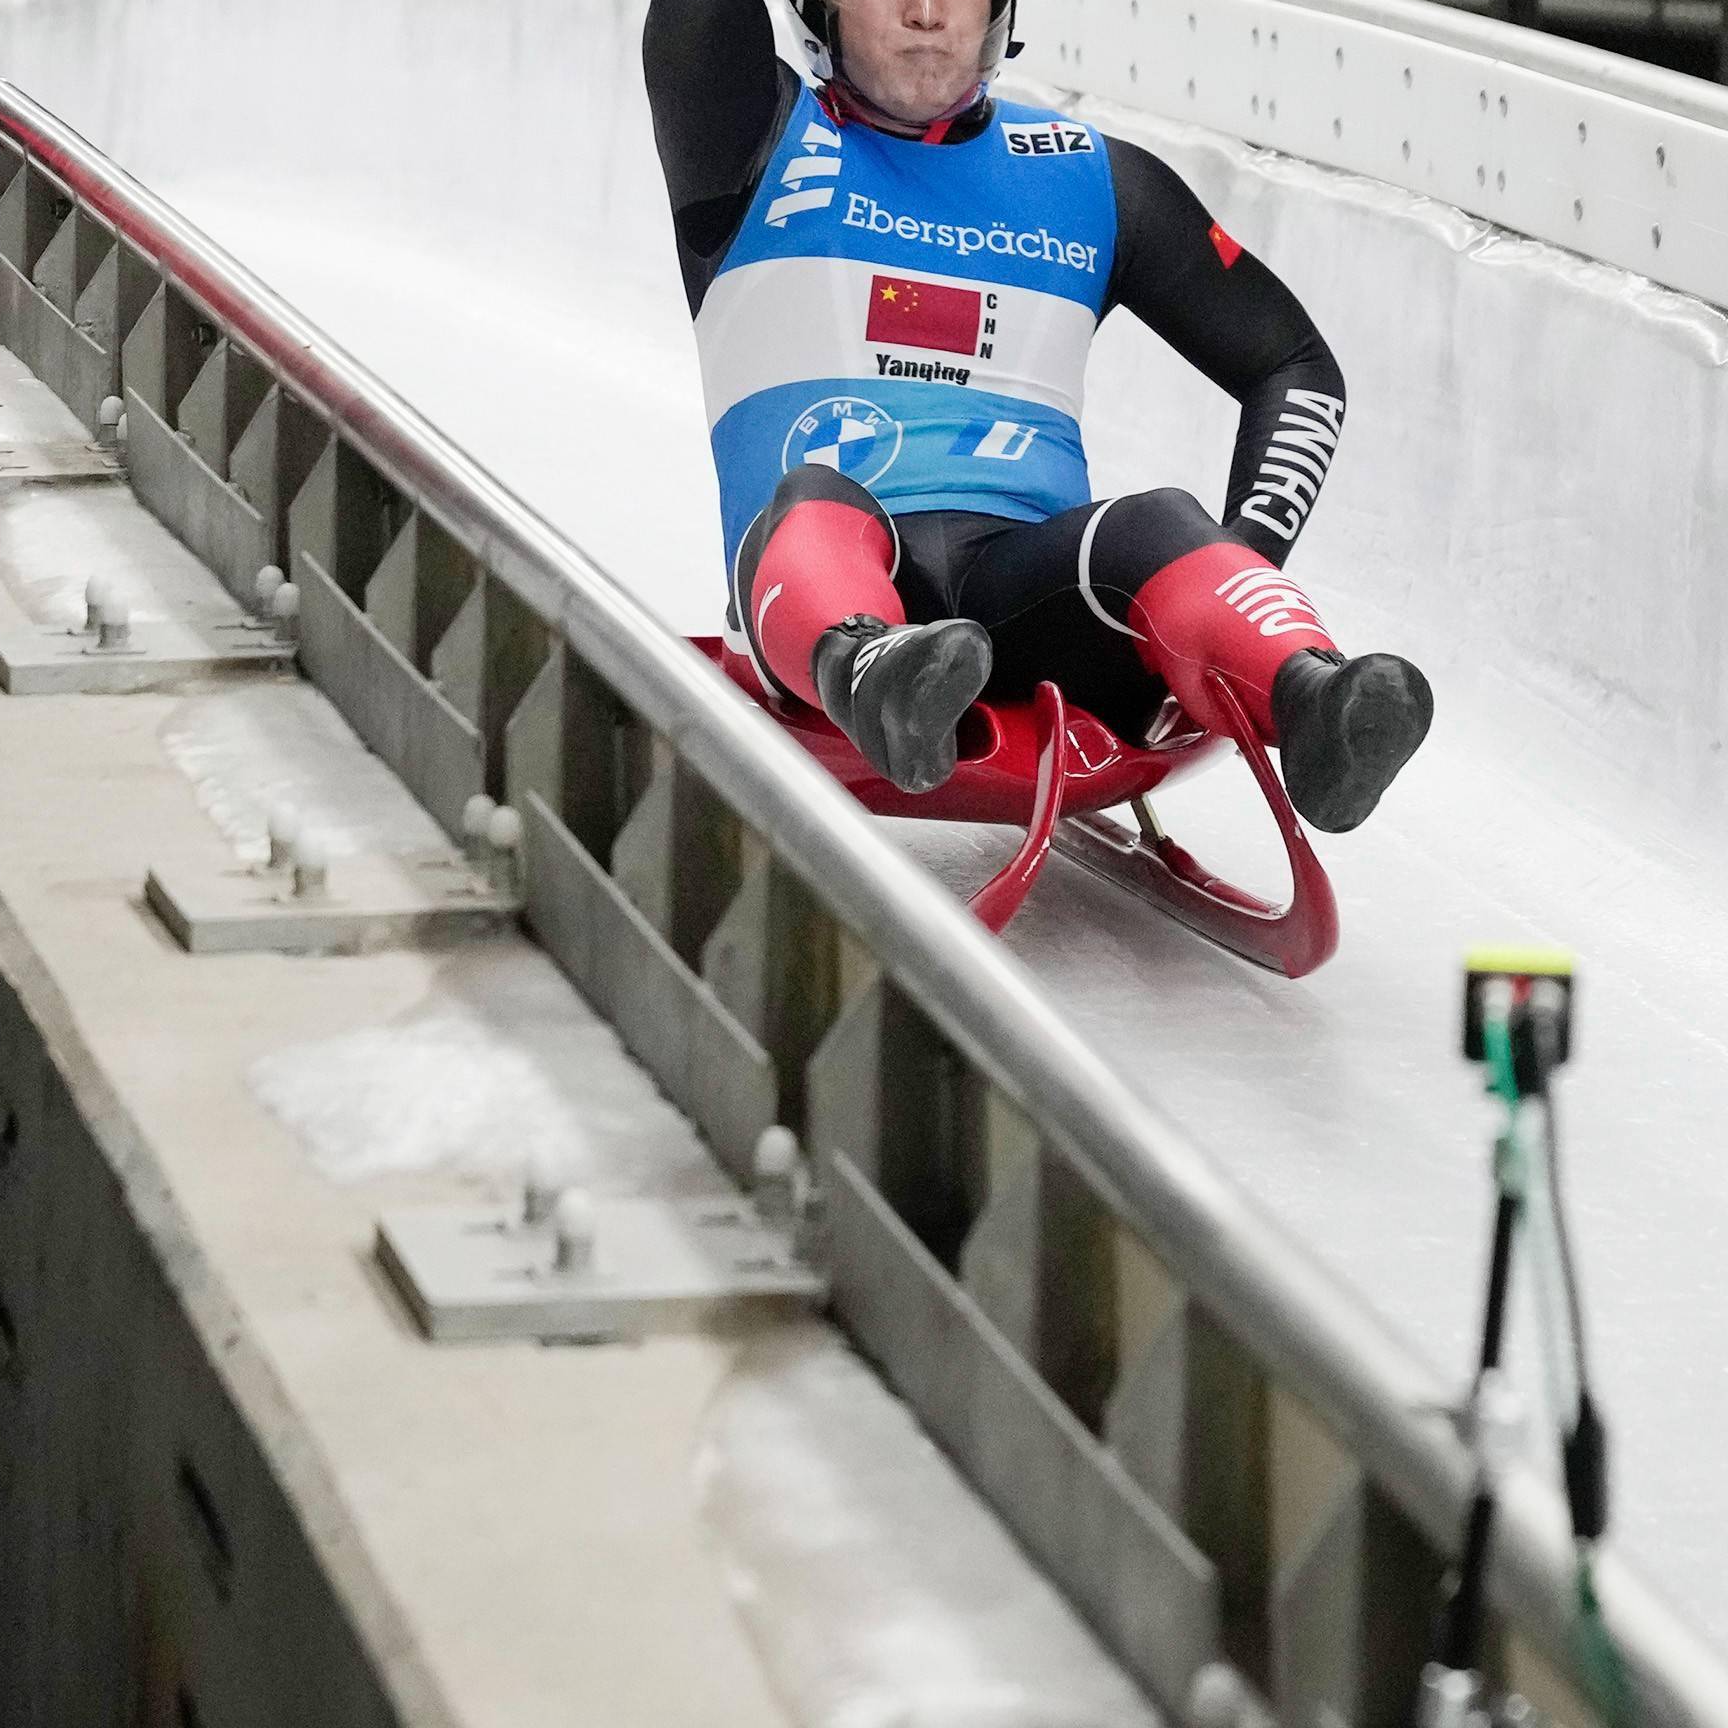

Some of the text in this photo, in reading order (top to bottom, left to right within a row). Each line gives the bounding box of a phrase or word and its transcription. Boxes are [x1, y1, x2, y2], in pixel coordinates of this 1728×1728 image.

[842, 192, 1098, 274] Eberspächer
[876, 353, 971, 386] Yanqing
[1239, 388, 1345, 541] CHINA
